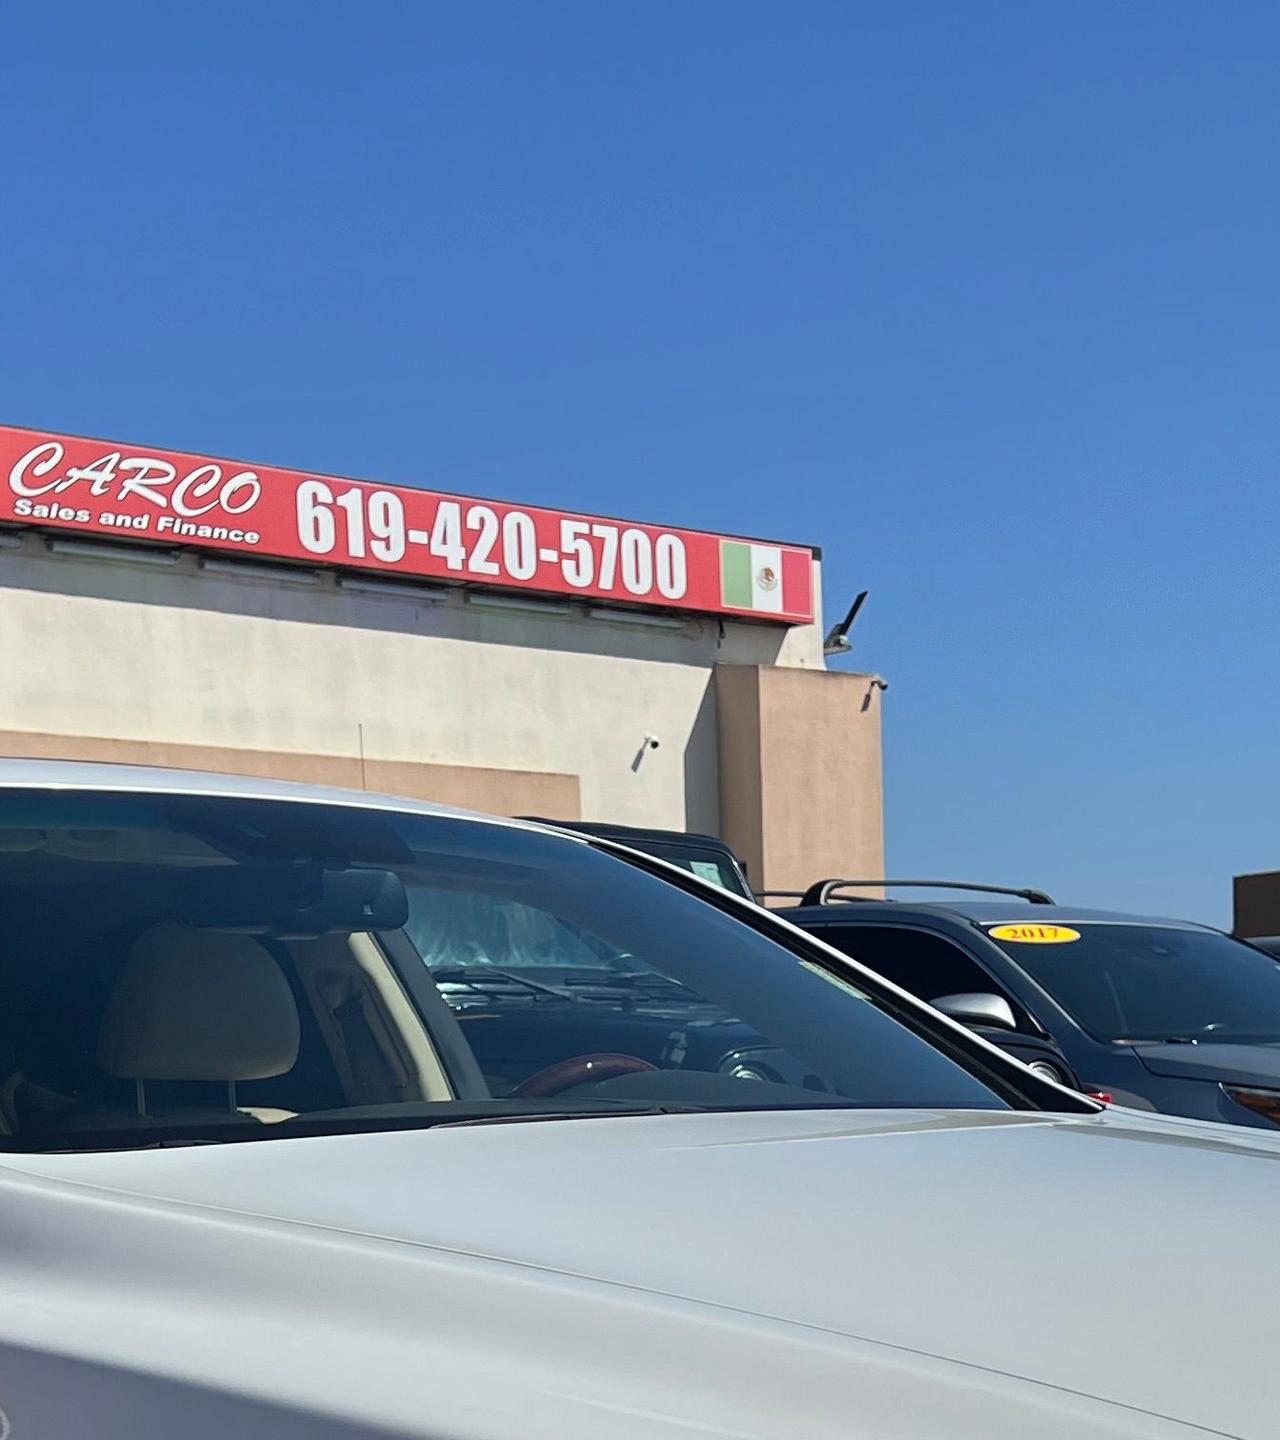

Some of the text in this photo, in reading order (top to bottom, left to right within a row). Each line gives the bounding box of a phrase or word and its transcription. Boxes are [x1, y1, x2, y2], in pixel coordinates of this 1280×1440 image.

[8, 441, 262, 518] CARCO
[13, 498, 261, 545] Sales and Finance
[294, 478, 688, 600] 619-420-5700
[1006, 927, 1059, 939] 2017
